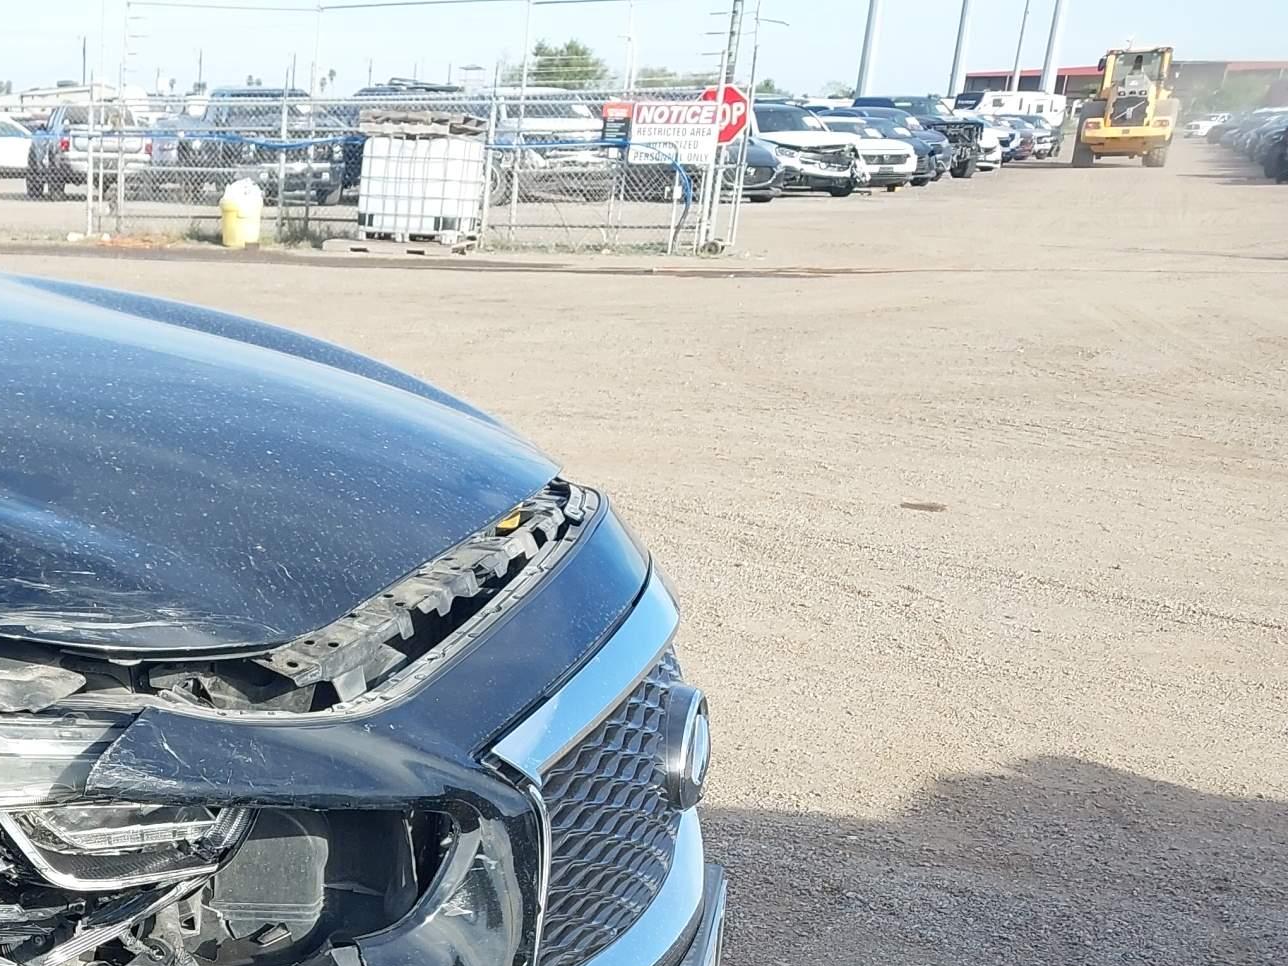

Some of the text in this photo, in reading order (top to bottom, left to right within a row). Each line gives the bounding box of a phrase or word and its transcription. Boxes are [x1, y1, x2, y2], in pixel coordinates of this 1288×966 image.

[638, 105, 716, 124] NOTICE
[637, 127, 687, 137] RESTRICTED
[690, 127, 712, 136] AREA
[687, 153, 709, 162] ONLY
